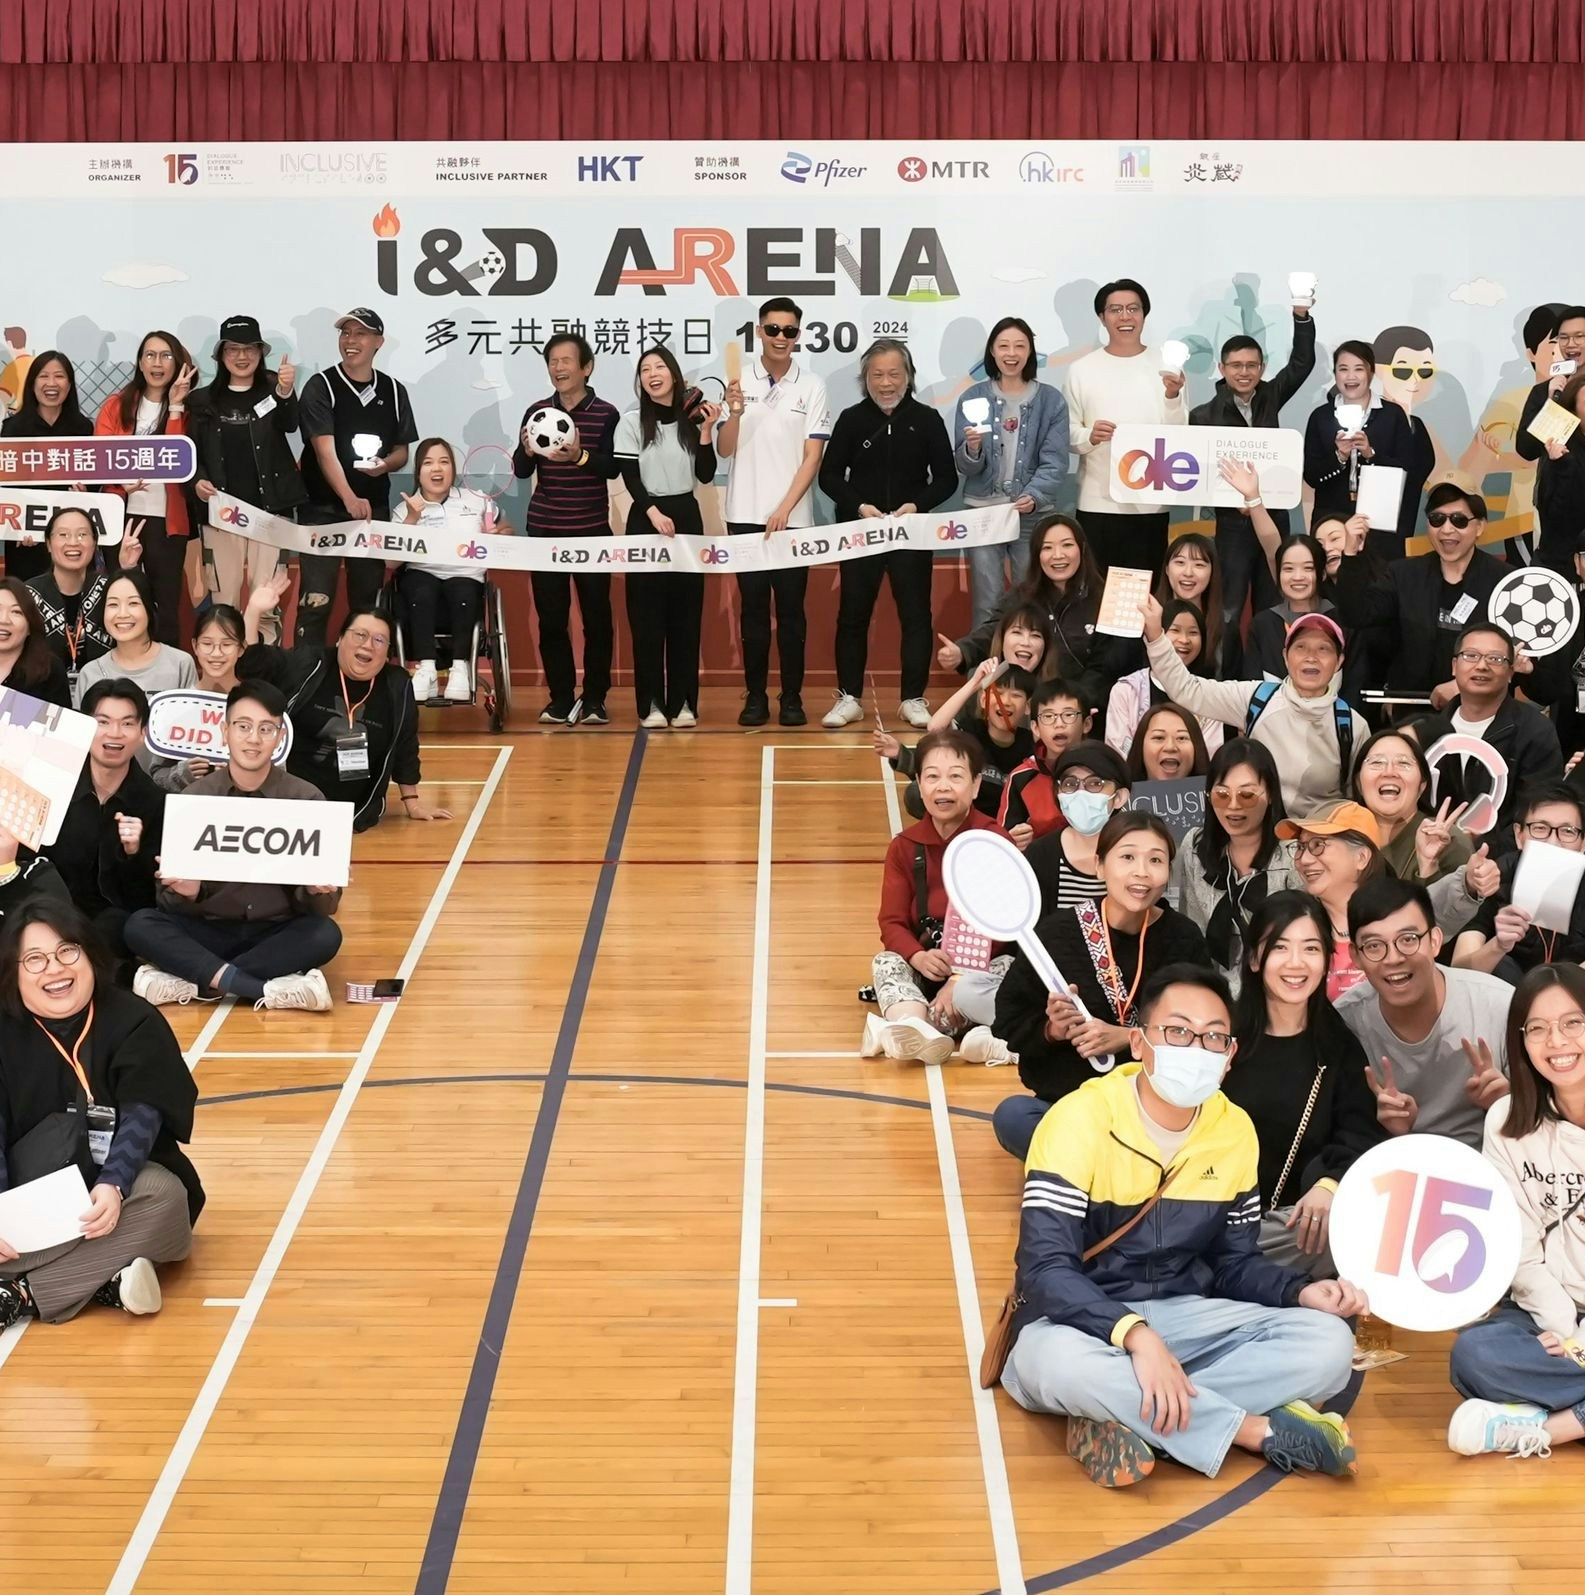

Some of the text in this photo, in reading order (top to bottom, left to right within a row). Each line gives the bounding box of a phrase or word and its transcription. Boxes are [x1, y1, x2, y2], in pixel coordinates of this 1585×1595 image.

[280, 152, 388, 173] INCLUSIVE
[577, 155, 645, 182] HKT
[931, 160, 991, 179] MTR
[88, 174, 142, 182] ORGANIZER
[435, 172, 548, 181] INCLUSIVE PARTNER
[694, 172, 747, 181] SPONSOR
[814, 158, 868, 188] Pfizer
[594, 227, 960, 297] ARENA
[872, 321, 909, 333] 2024
[1215, 439, 1269, 449] DIALOGUE
[104, 445, 181, 472] 15週年
[1215, 450, 1279, 460] EXPERIENCE
[355, 532, 428, 555] ARENA
[837, 525, 910, 551] ARENA
[596, 546, 673, 564] ARENA
[201, 708, 225, 725] W
[169, 725, 214, 745] DID
[193, 824, 321, 857] AECOM
[1370, 1168, 1494, 1294] 15
